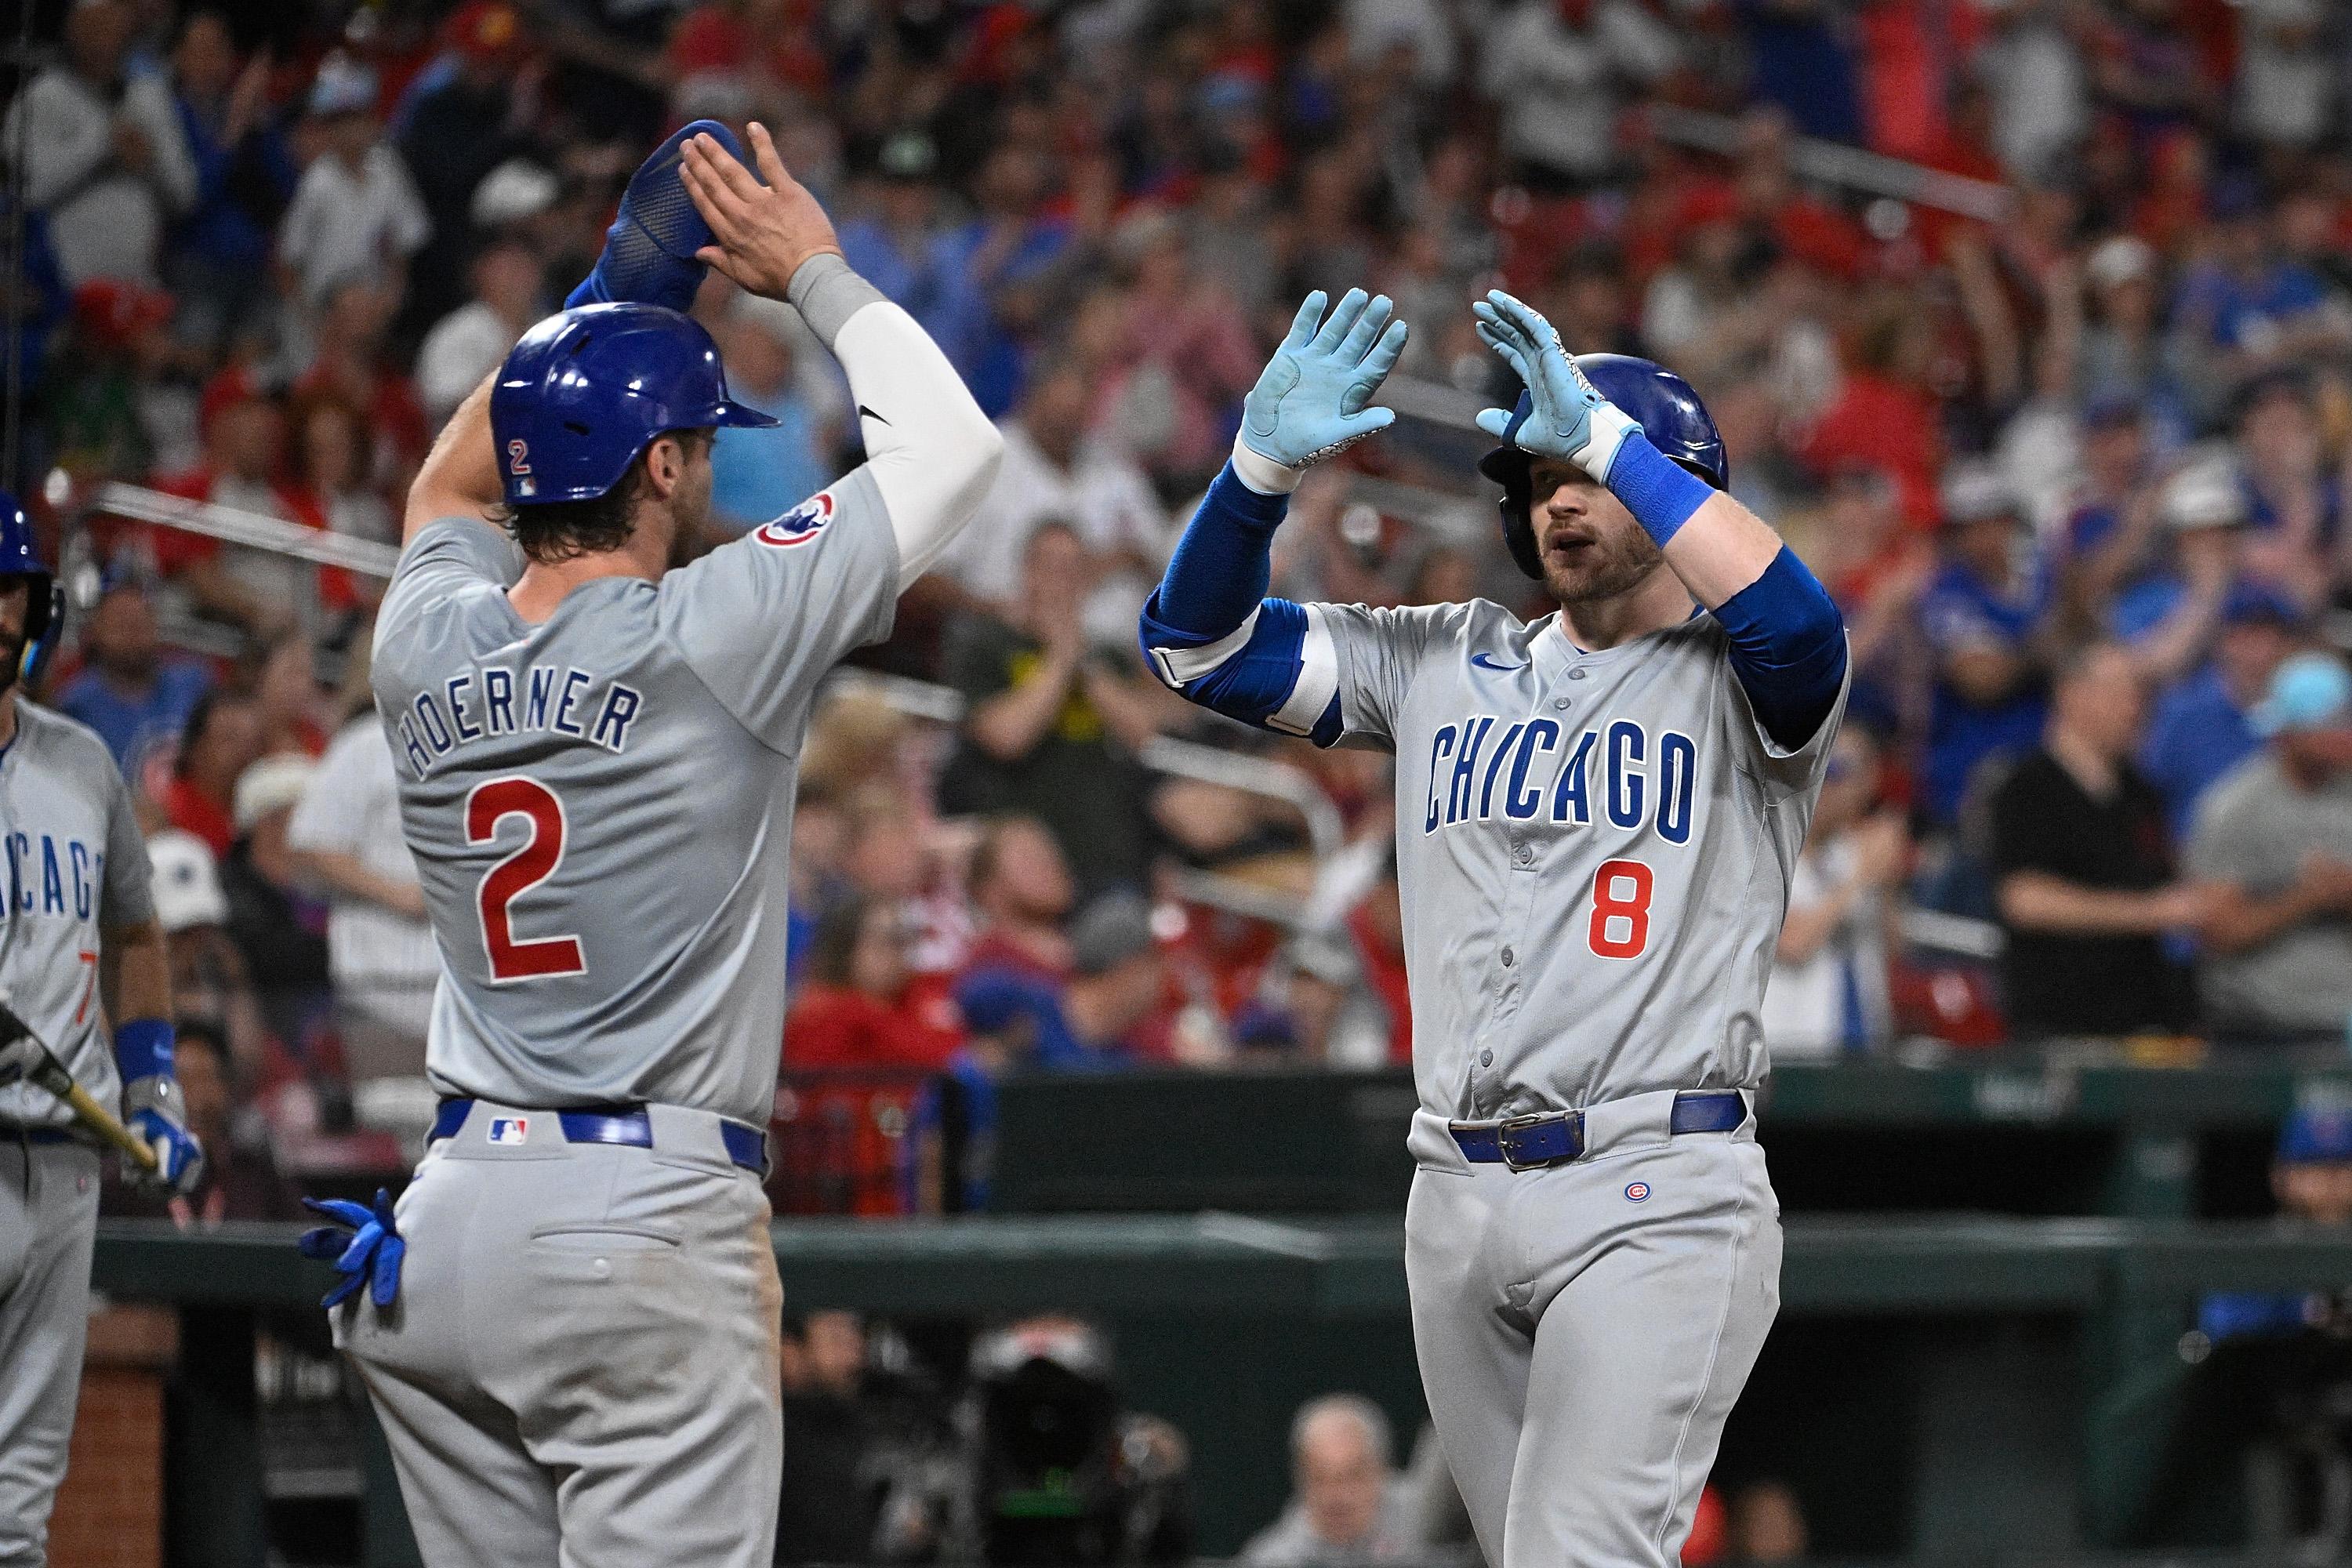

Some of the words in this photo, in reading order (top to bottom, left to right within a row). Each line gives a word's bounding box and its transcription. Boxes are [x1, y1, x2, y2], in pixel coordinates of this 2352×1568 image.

[508, 440, 532, 475] 2
[398, 666, 642, 782] HOERNER
[1425, 714, 1698, 847] CHICAGO
[0, 832, 103, 920] ICAG
[465, 775, 587, 985] 2
[1587, 858, 1655, 961] 8
